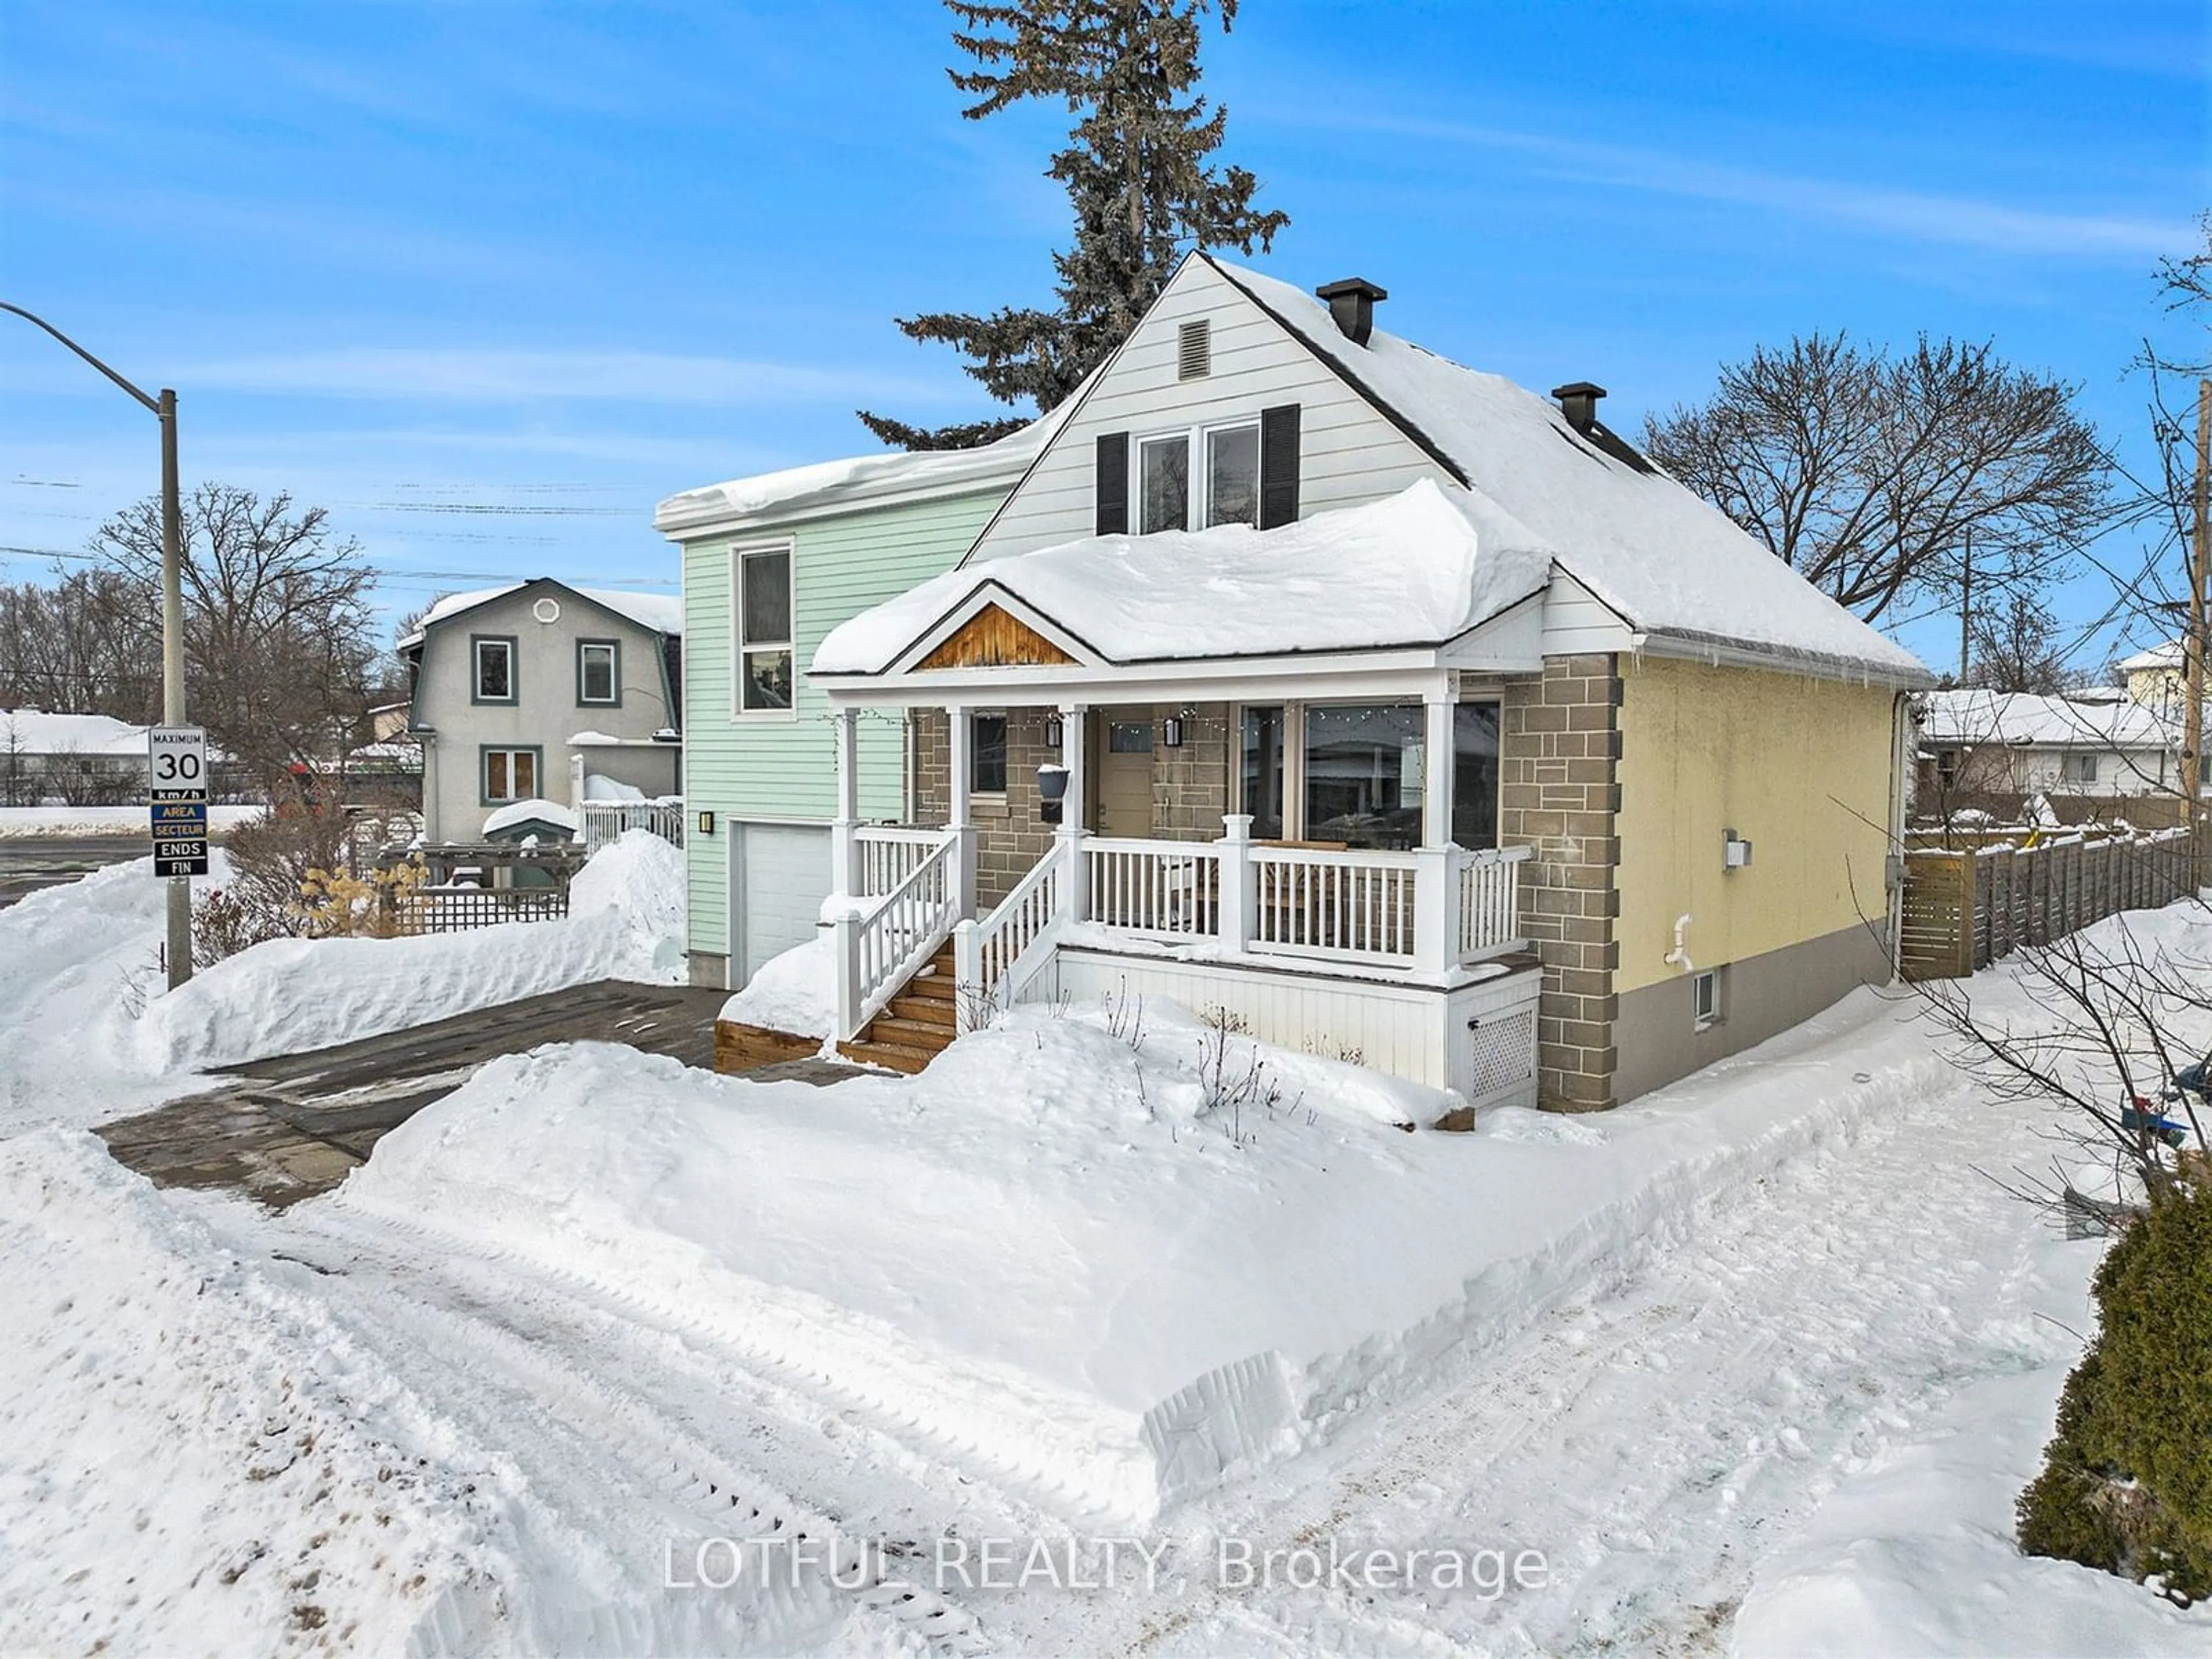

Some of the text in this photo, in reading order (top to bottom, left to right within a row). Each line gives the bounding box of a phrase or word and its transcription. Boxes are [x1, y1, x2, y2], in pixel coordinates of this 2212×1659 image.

[153, 734, 201, 744] MAXIMUM
[157, 753, 199, 780] 30
[158, 790, 200, 800] km/h
[162, 807, 196, 817] AREA
[154, 824, 204, 835] SECTEUR
[161, 843, 200, 855] ENDS
[171, 862, 192, 874] FIN
